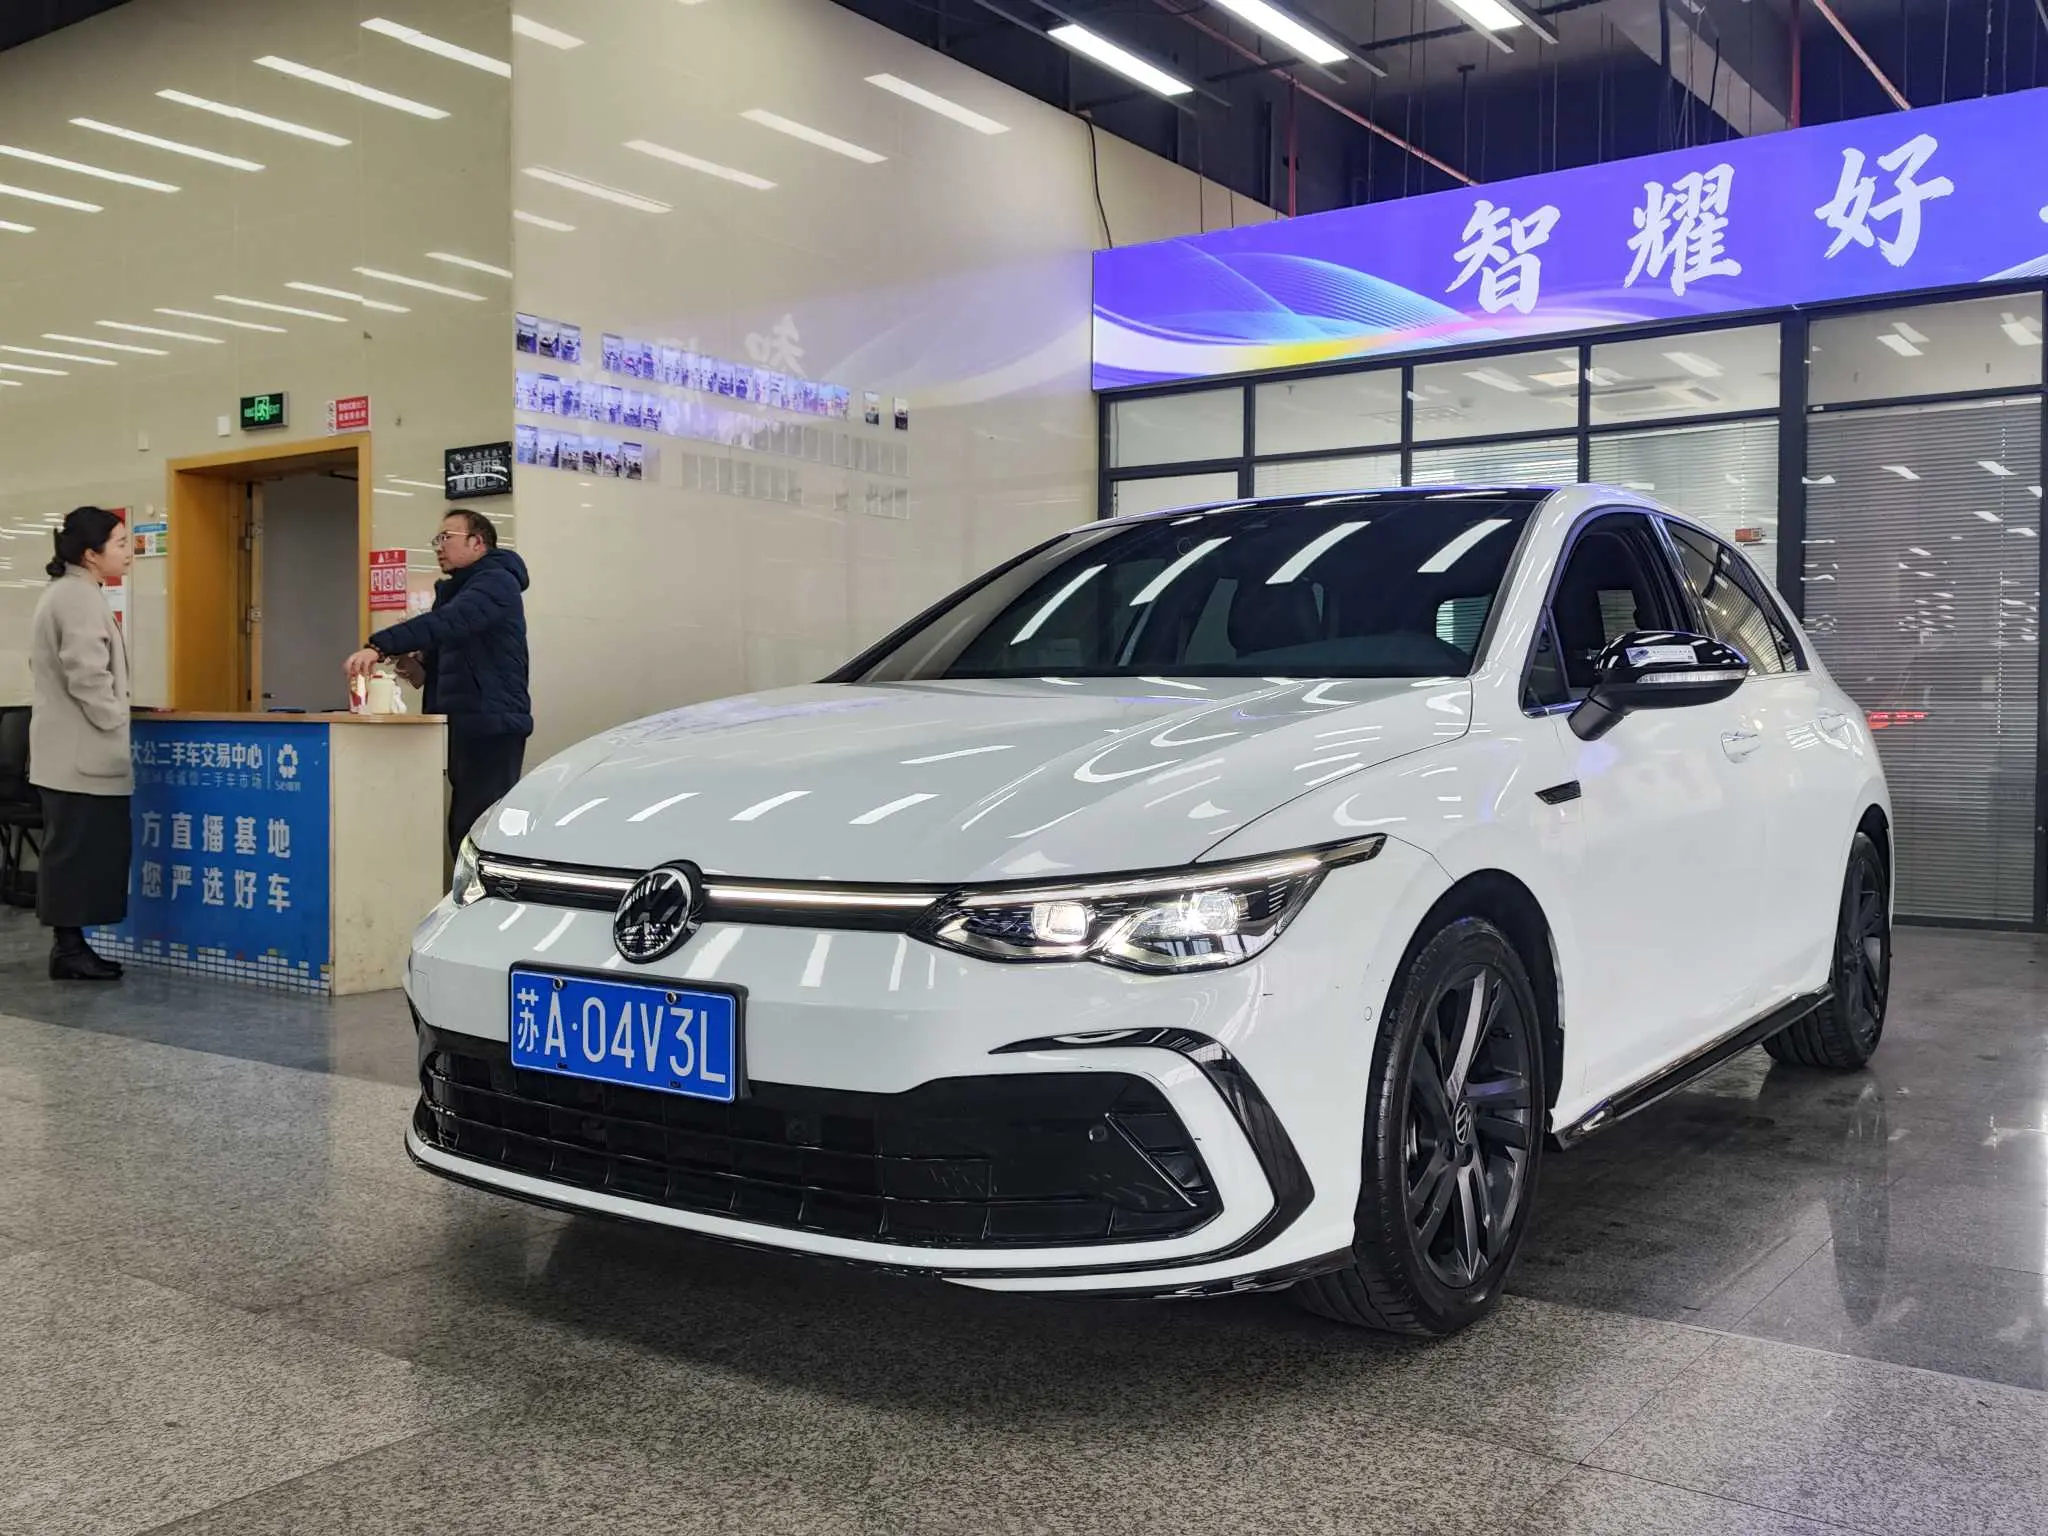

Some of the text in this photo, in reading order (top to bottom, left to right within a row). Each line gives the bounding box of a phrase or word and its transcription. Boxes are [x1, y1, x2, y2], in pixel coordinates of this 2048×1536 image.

[1445, 133, 2048, 314] 智耀好
[131, 741, 263, 769] 大公二手车交易中心
[129, 811, 291, 858] 方直播基地
[128, 861, 291, 913] 您严选好车
[517, 987, 726, 1083] 苏A·04V3L
